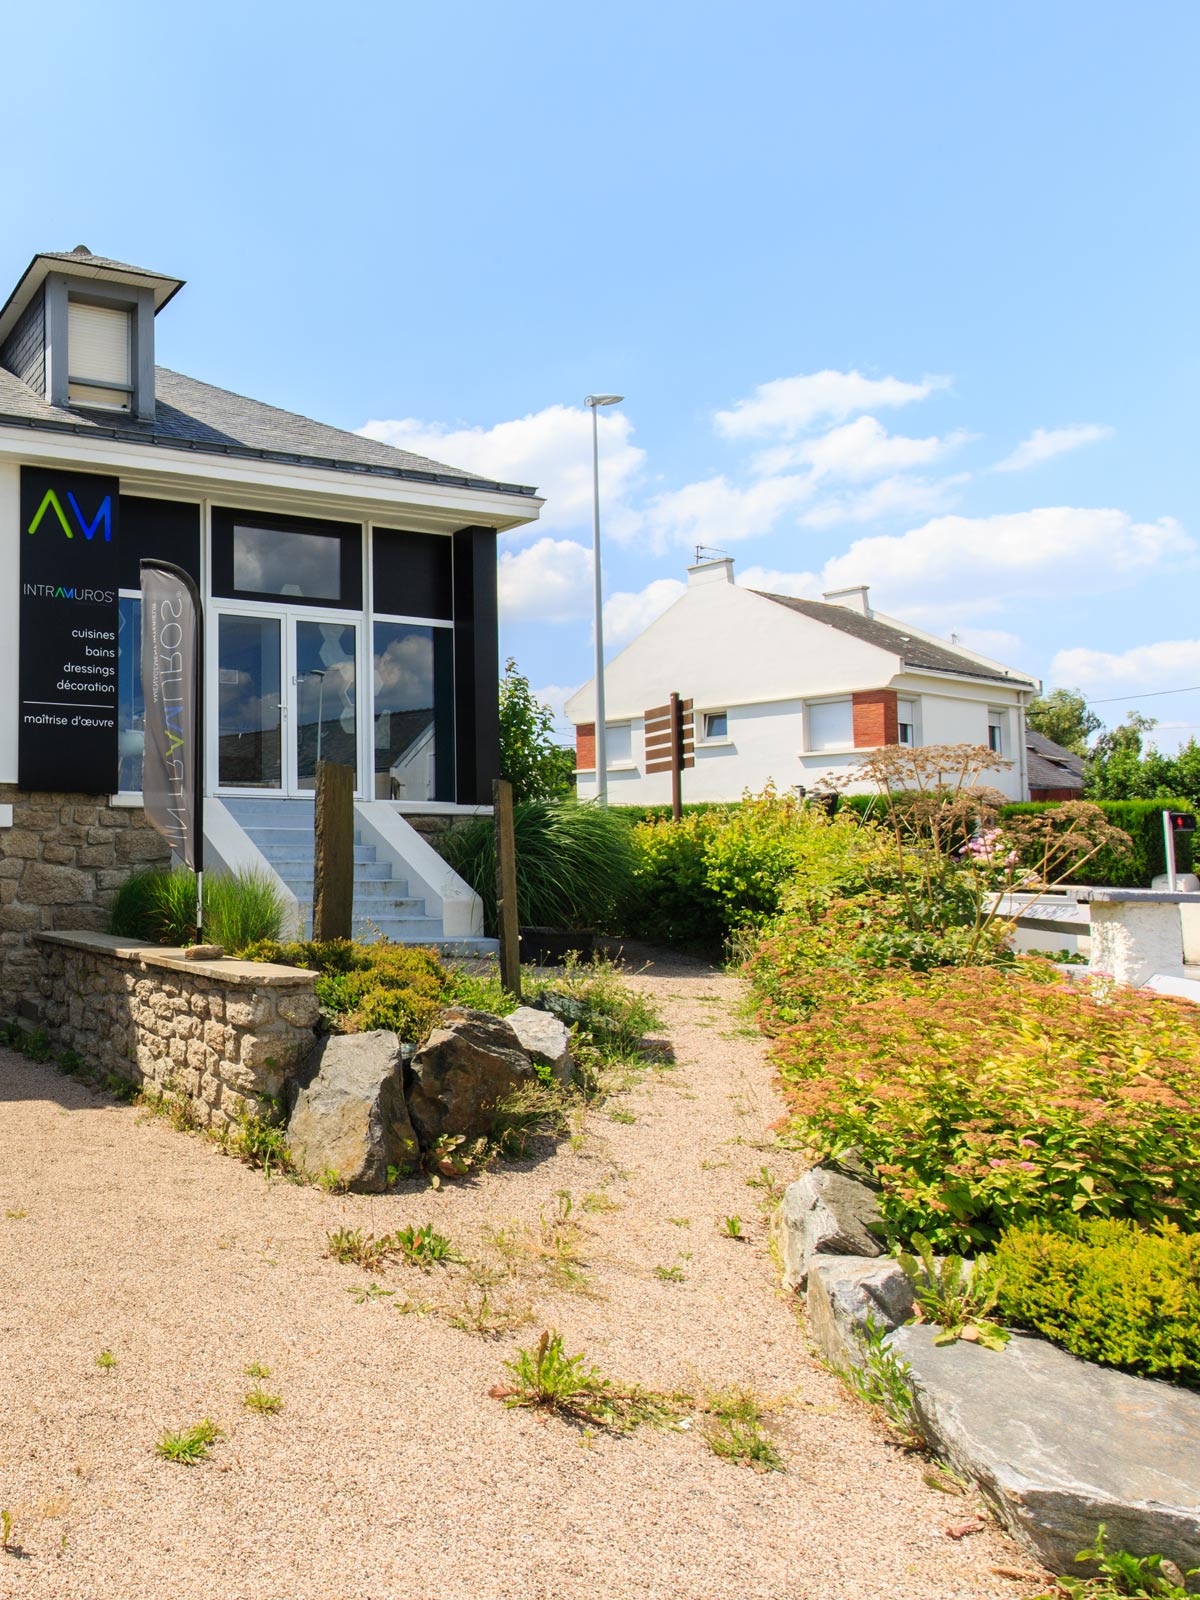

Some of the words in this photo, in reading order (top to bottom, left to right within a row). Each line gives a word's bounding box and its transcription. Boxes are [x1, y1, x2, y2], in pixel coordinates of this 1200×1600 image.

[71, 628, 115, 640] cuisines
[85, 645, 115, 658] bains
[63, 662, 115, 677] dressings
[56, 679, 115, 693] décoration
[24, 714, 68, 726] maîtrise
[71, 715, 115, 728] d'œuvre
